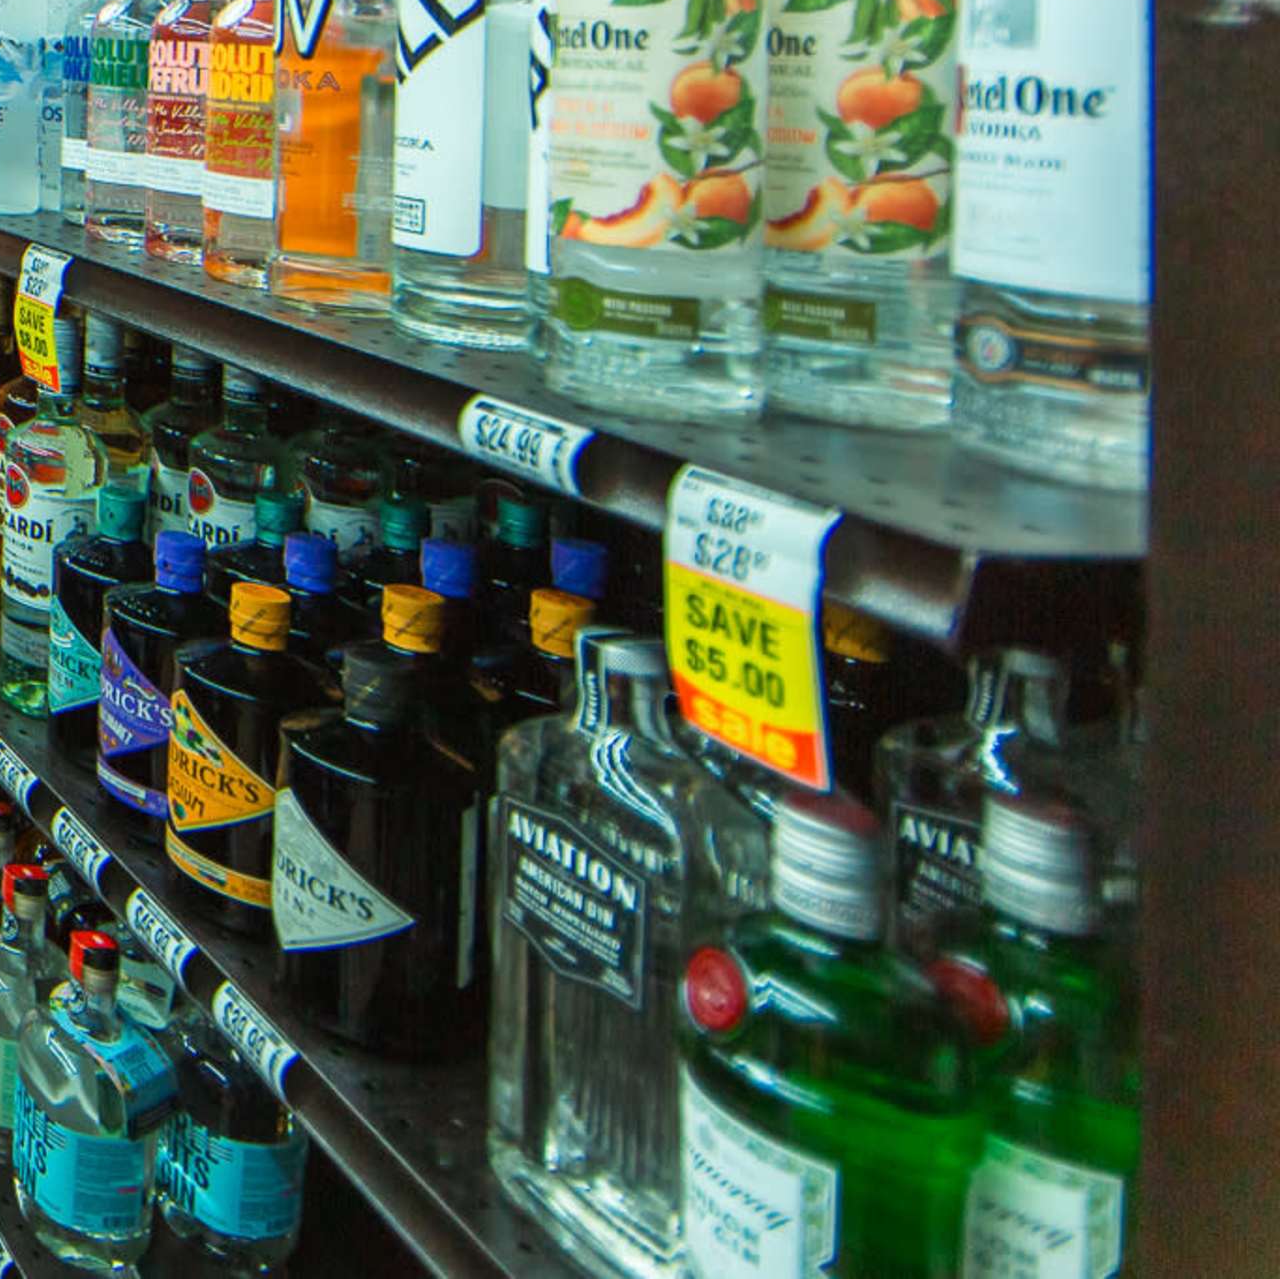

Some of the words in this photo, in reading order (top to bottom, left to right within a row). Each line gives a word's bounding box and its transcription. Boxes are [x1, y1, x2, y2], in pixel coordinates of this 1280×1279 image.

[590, 20, 649, 52] One
[766, 25, 817, 58] One
[1015, 76, 1108, 119] One
[684, 593, 782, 662] SAVE
[683, 638, 786, 709] $5.00
[692, 696, 798, 770] sale
[508, 810, 638, 911] AVIATION
[585, 897, 616, 929] GIN
